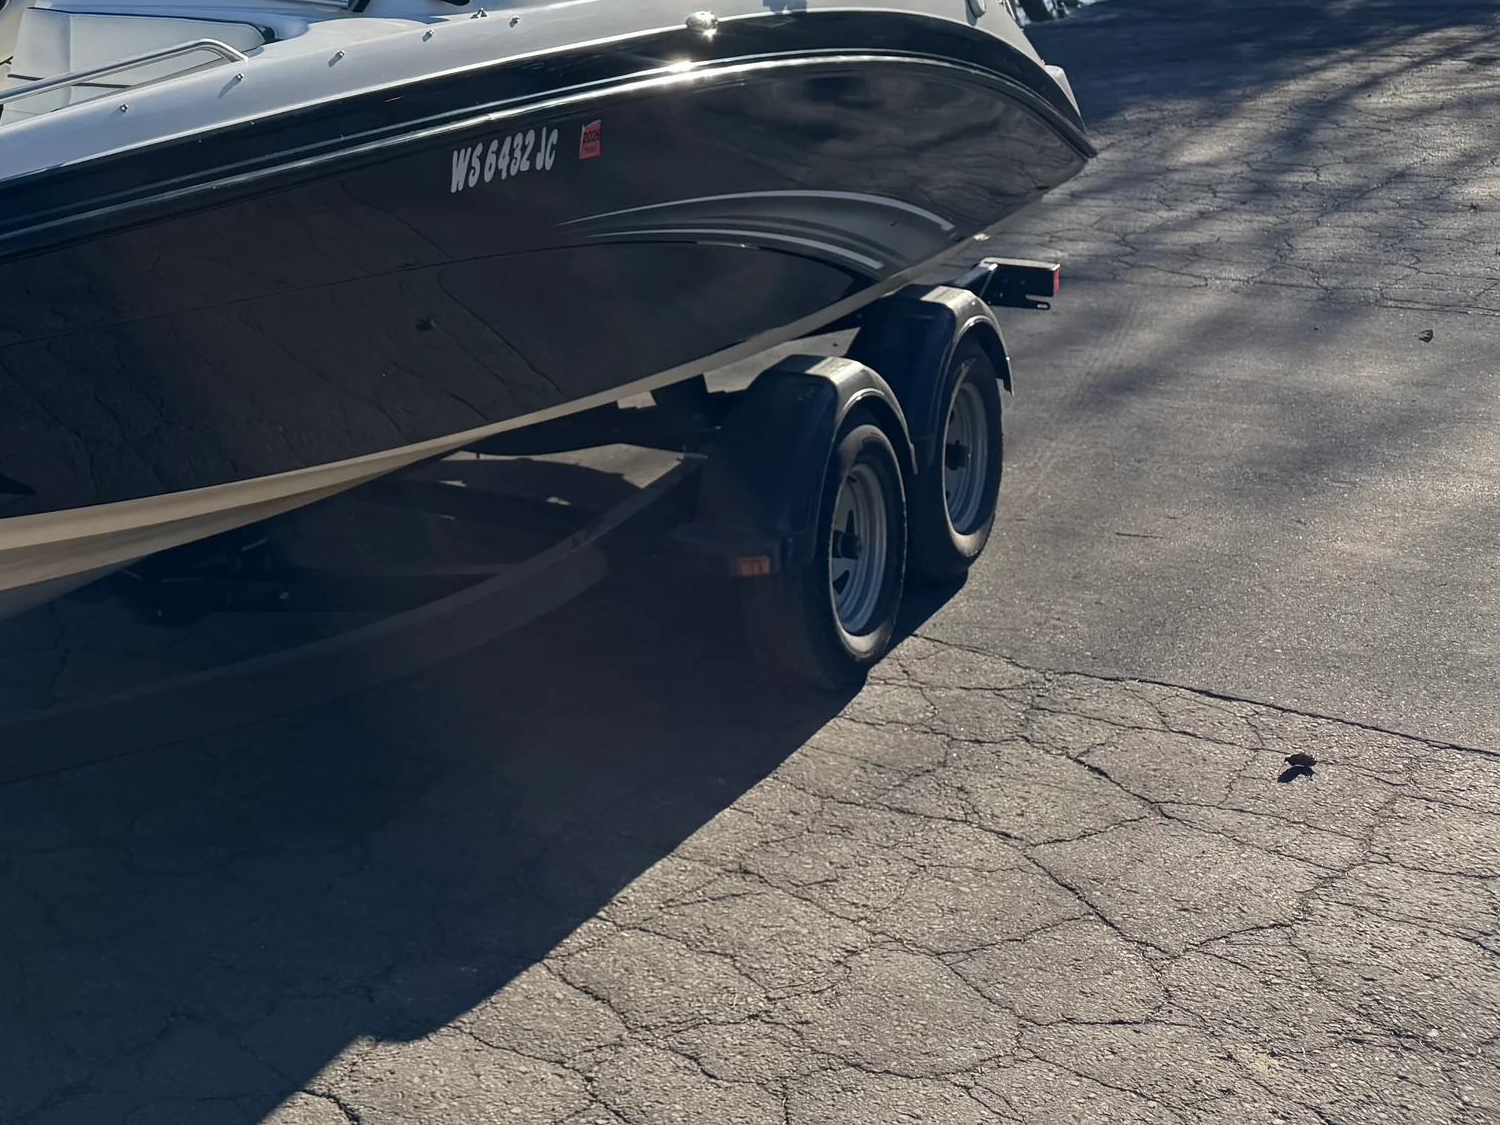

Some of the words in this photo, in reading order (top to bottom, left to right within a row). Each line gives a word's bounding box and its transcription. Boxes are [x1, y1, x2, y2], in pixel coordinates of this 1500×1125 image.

[450, 142, 483, 193] WS
[483, 129, 536, 183] 6432
[535, 126, 559, 171] JC
